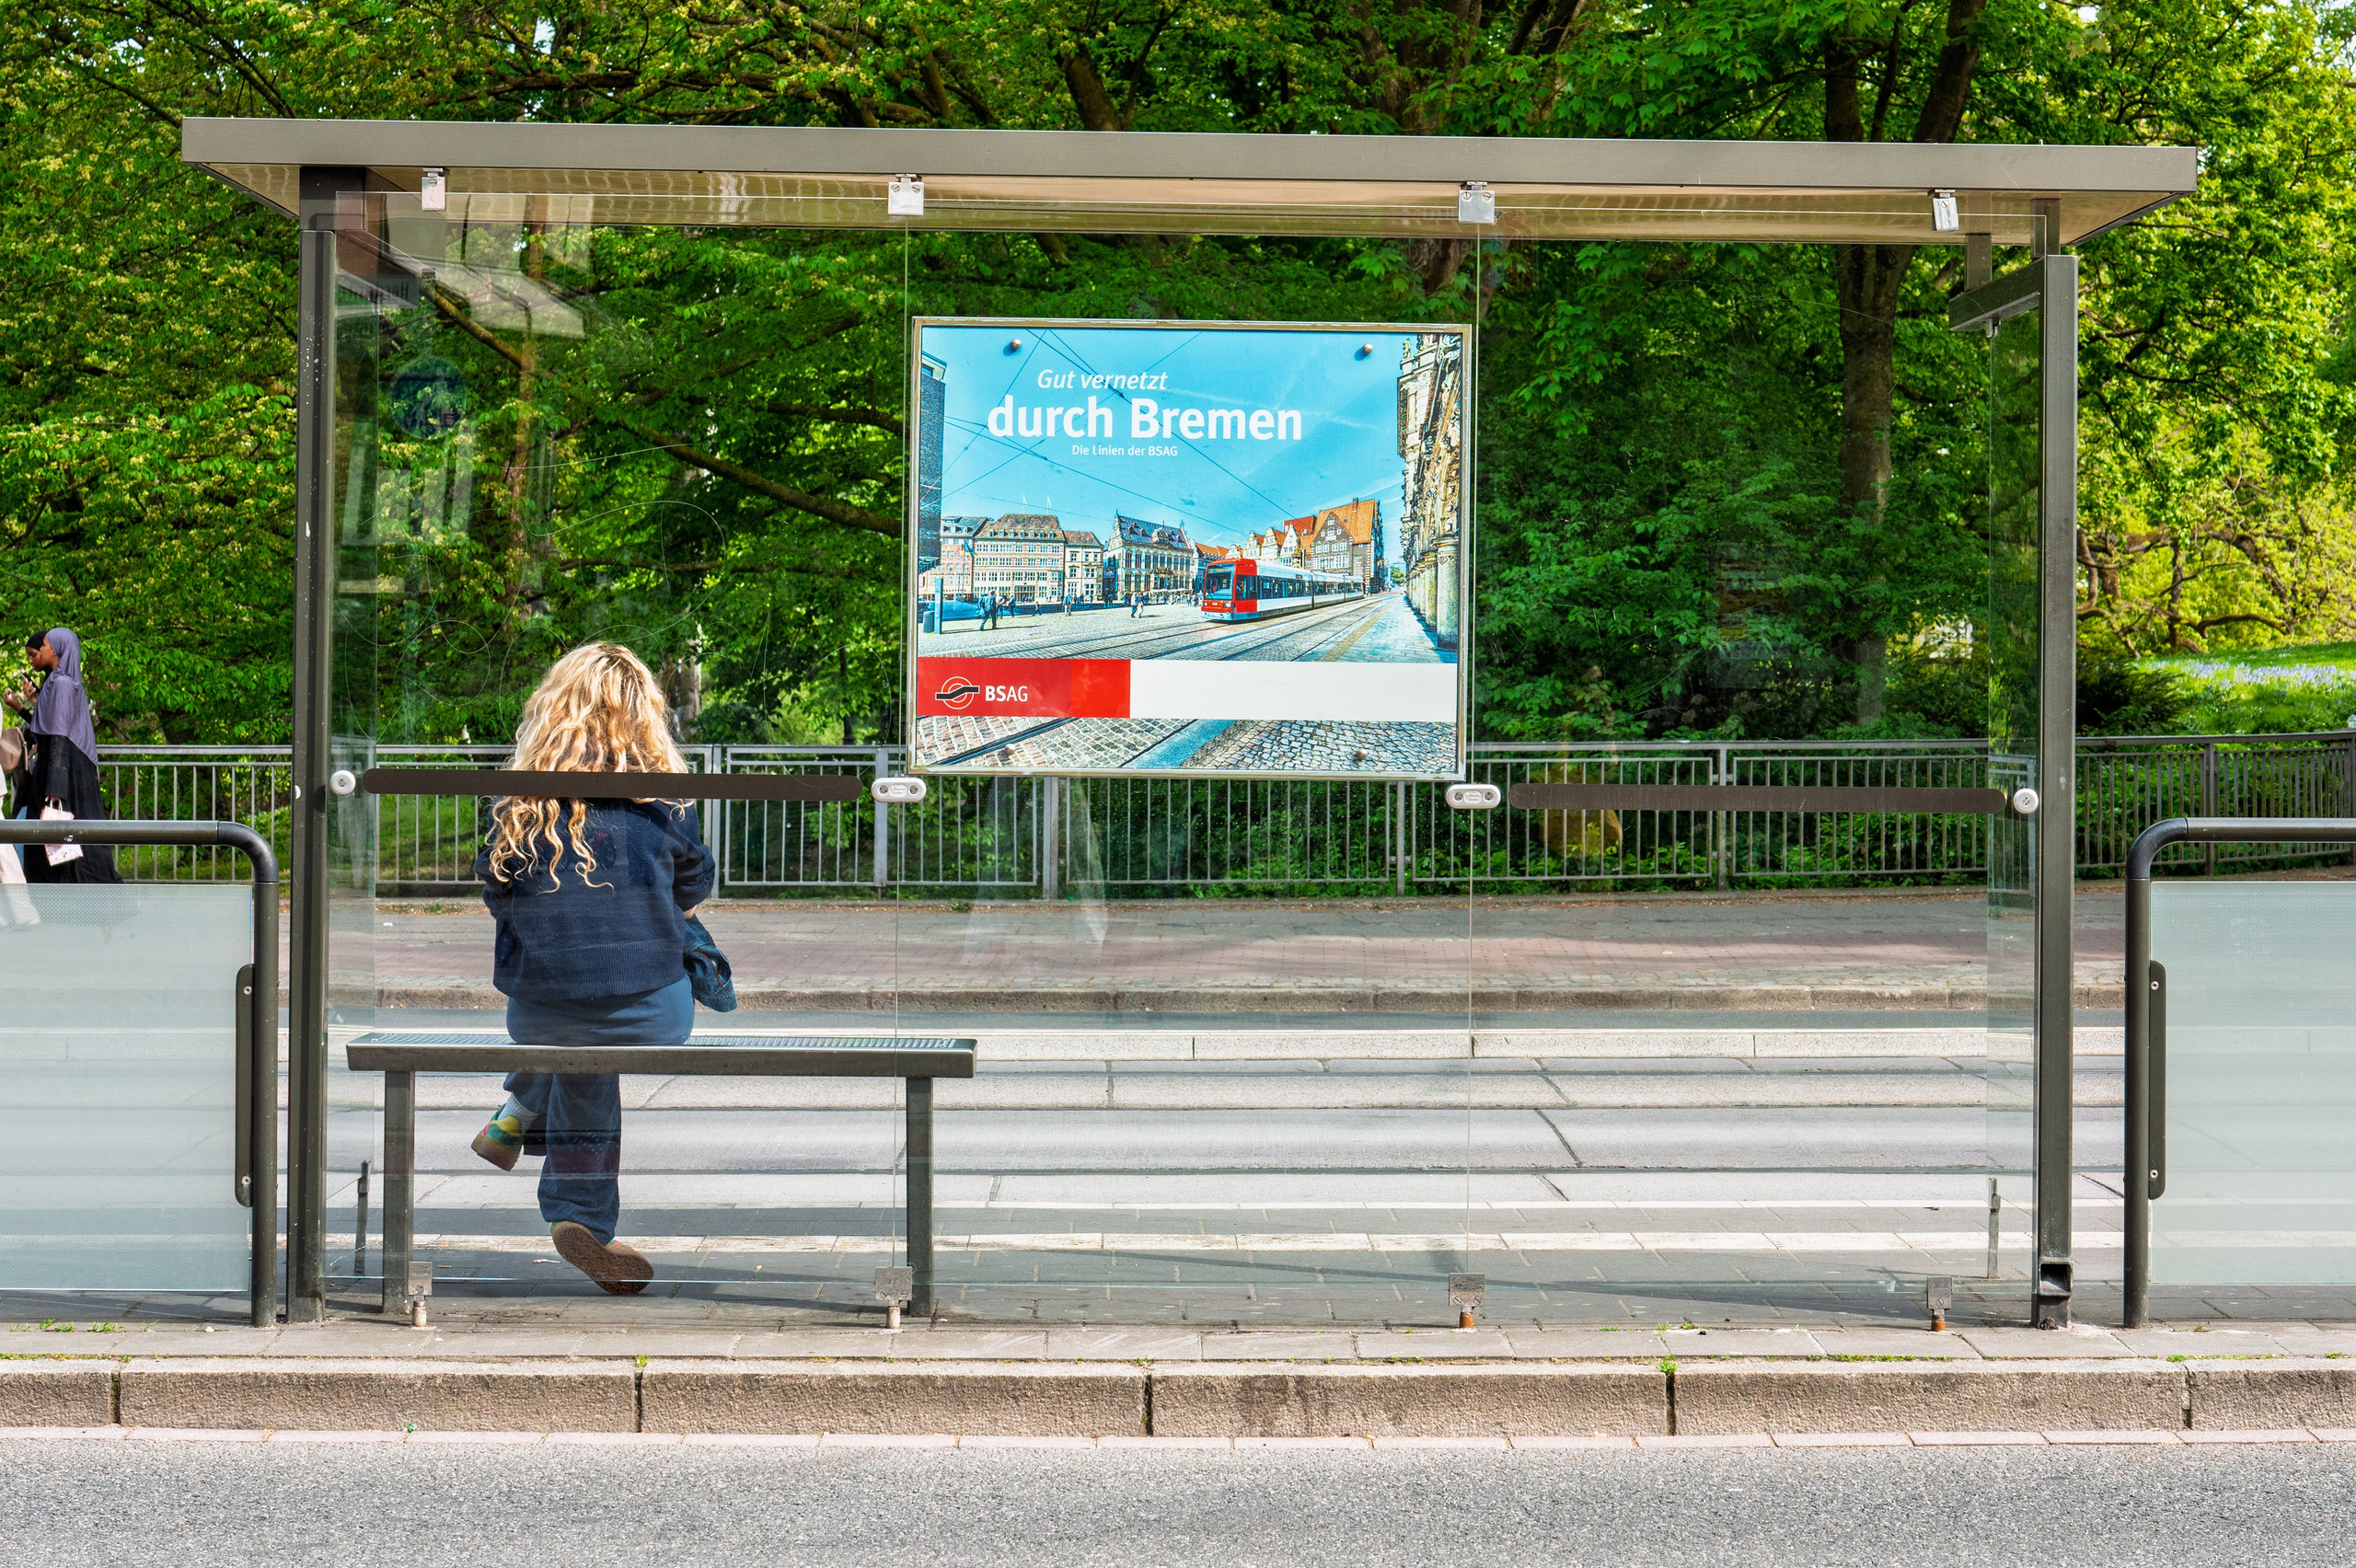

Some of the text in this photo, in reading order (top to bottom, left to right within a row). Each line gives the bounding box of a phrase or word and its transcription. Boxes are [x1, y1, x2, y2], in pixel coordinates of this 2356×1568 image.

[1037, 368, 1169, 390] Gut vernetzt
[987, 394, 1302, 440] durch Bremen
[1071, 444, 1178, 456] Die Linien der BSAG
[985, 685, 1029, 702] BSAG
